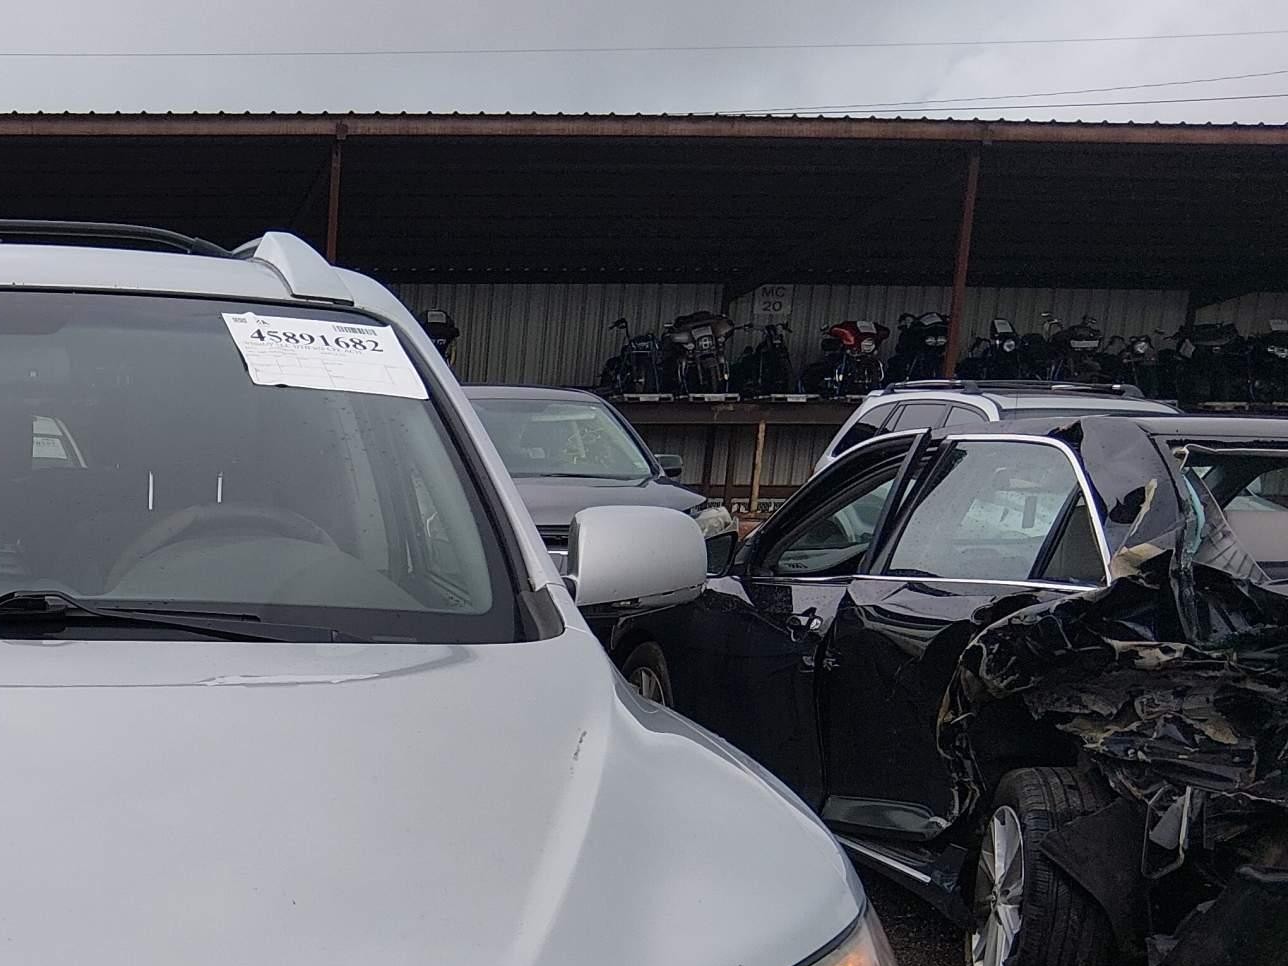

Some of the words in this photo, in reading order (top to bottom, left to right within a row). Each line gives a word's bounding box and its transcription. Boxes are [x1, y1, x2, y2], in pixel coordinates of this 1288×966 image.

[762, 286, 786, 297] MC
[762, 301, 783, 312] 20
[250, 328, 384, 353] 45891682
